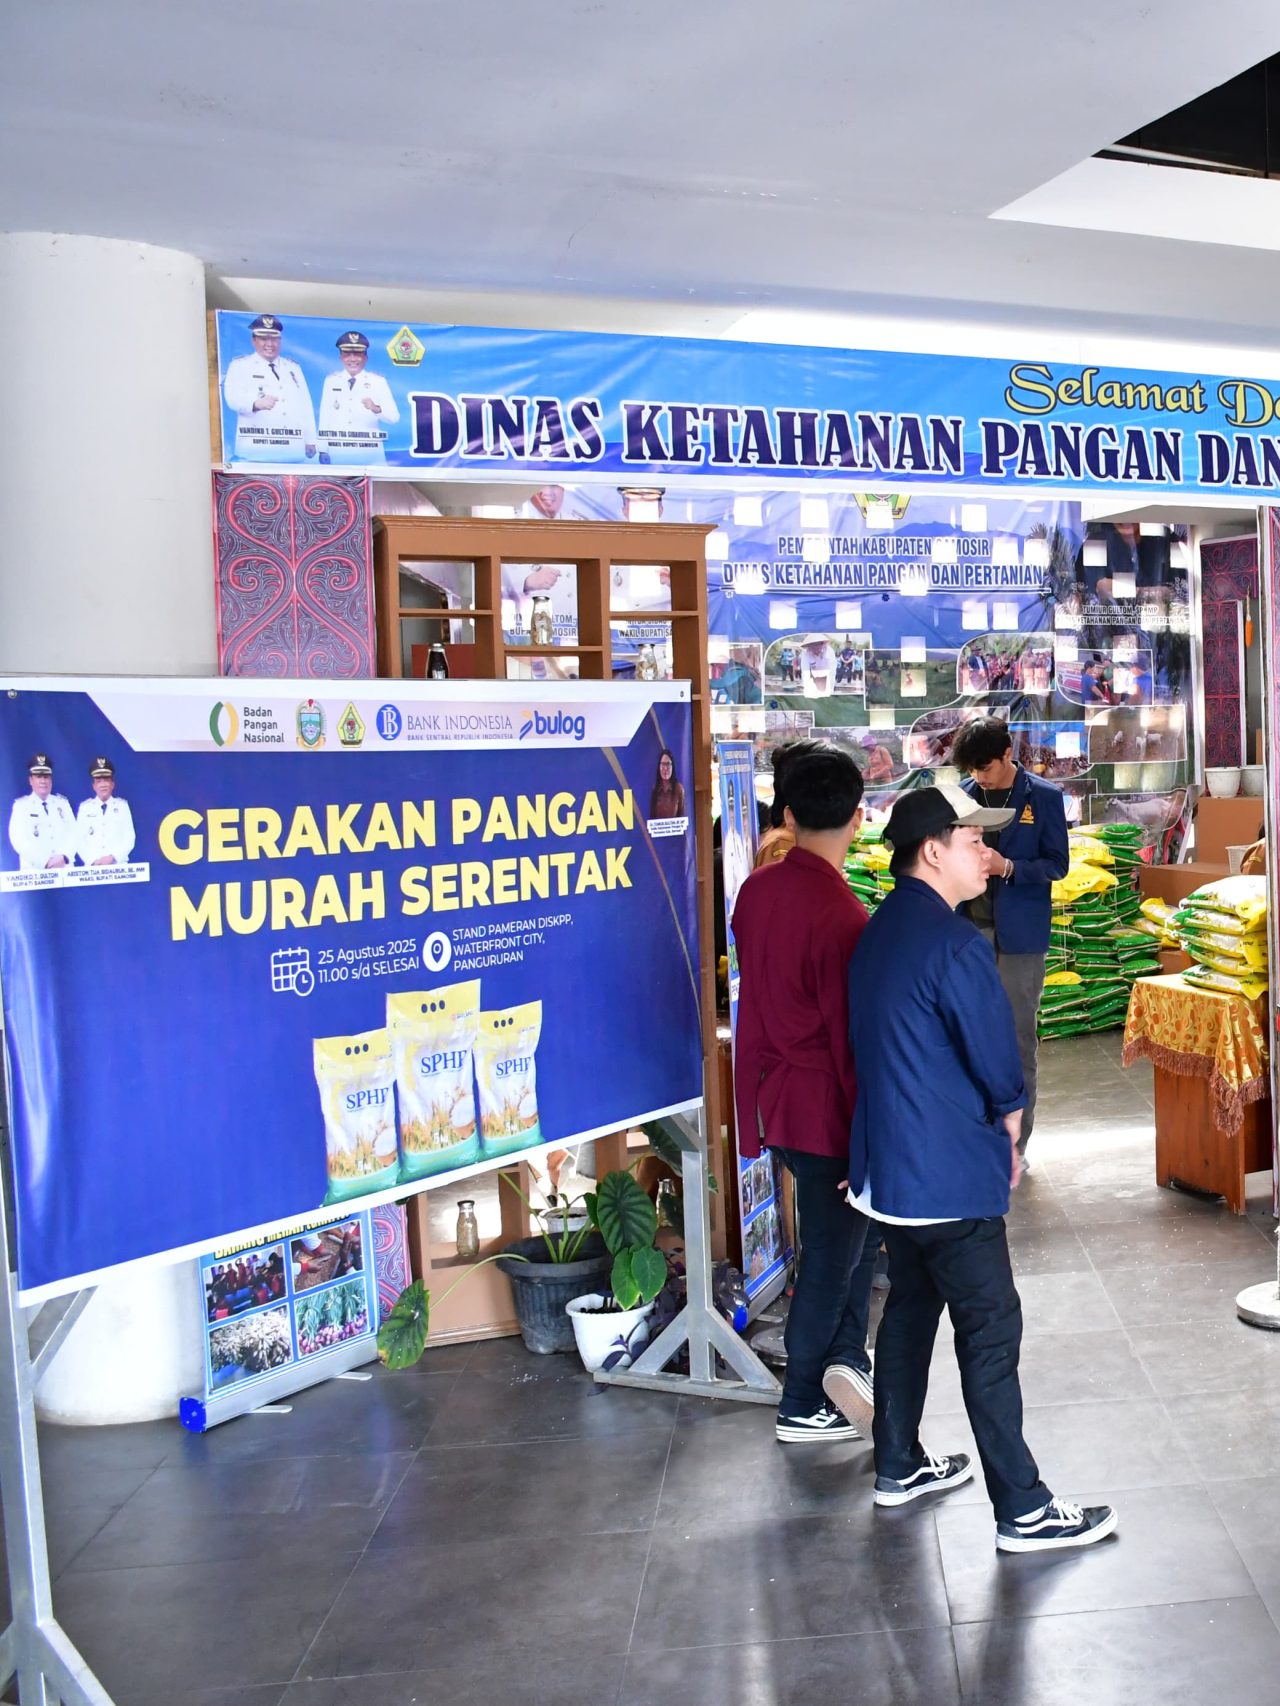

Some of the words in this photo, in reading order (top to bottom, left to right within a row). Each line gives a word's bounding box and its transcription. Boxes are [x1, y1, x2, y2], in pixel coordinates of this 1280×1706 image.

[1004, 363, 1208, 415] Selamat
[411, 395, 602, 460] DINAS
[623, 403, 962, 472] KETAHANAN
[981, 421, 1182, 481] PANGAN
[862, 537, 932, 556] KABUPATEN
[775, 564, 863, 585] KETAHANAN
[931, 565, 960, 585] DAN
[965, 565, 1043, 585] PERTANIAN
[641, 629, 665, 638] BUPATI
[244, 707, 272, 717] Badan
[407, 715, 440, 730] BANK
[445, 714, 513, 731] INDONESIA
[244, 719, 278, 731] Pangan
[534, 710, 586, 741] bulog
[244, 733, 284, 743] Nasional
[158, 800, 436, 866] GERAKAN
[451, 788, 634, 845] PANGAN
[170, 870, 386, 941] MURAH
[399, 846, 633, 916] SERENTAK
[453, 926, 487, 941] STAND
[489, 919, 537, 938] PAMERAN
[538, 914, 574, 929] DISKPP,
[318, 950, 334, 965] 25
[337, 944, 385, 965] Agustus
[387, 939, 417, 953] 2025
[453, 936, 522, 956] WATERFRONT
[523, 932, 546, 946] CITY,
[318, 967, 349, 983] 11.00
[351, 962, 371, 980] s/d
[373, 956, 419, 976] SELESAI
[453, 950, 524, 972] PANGURURAN
